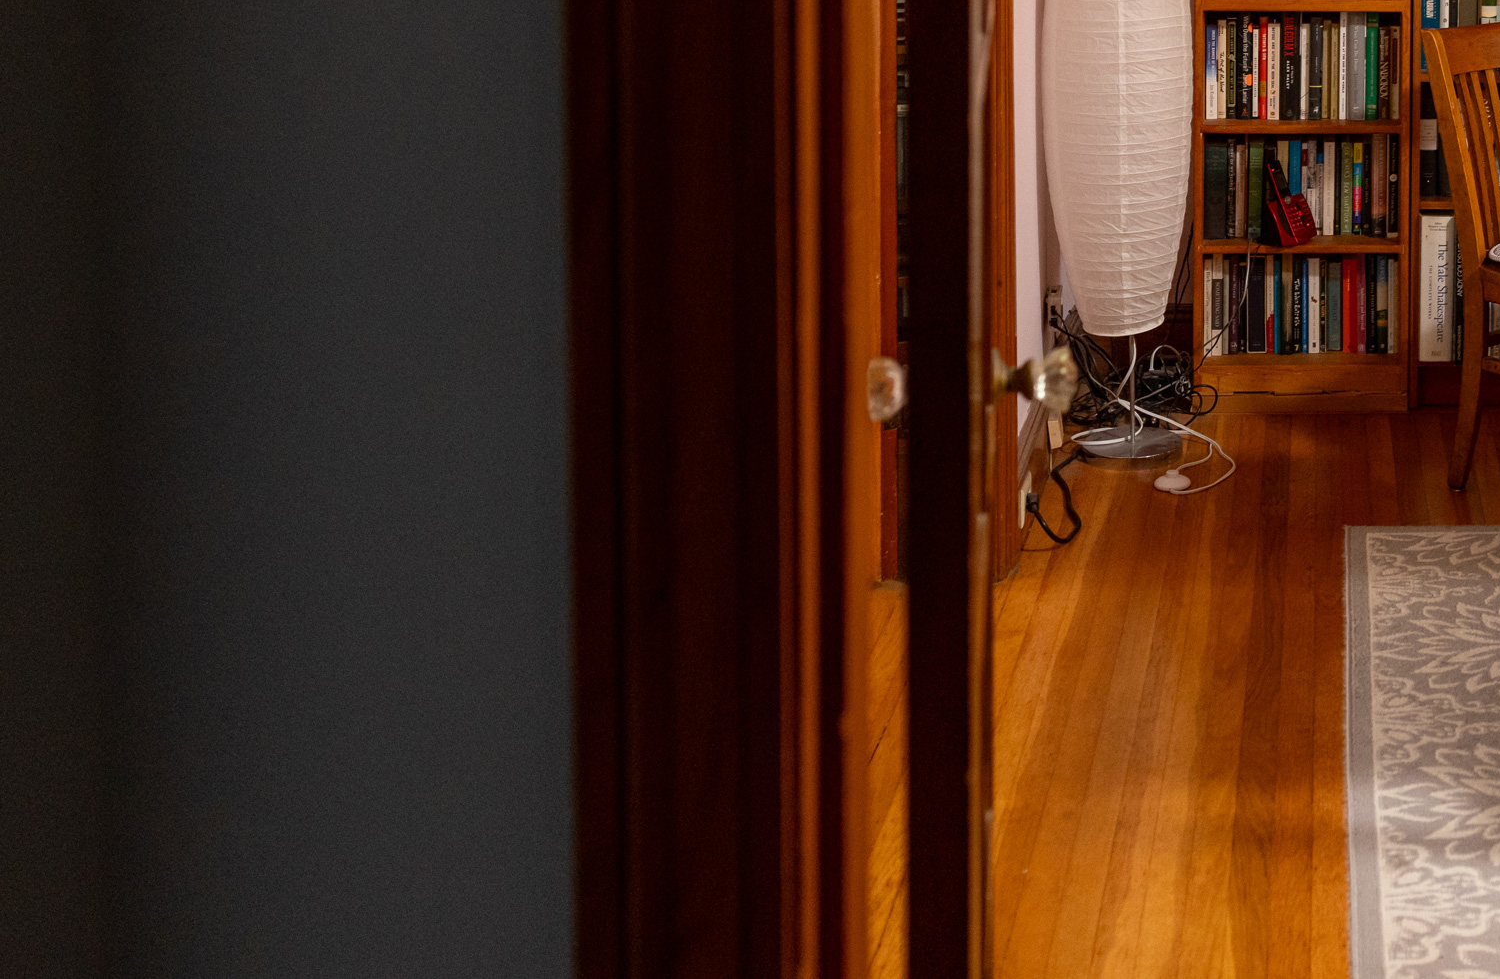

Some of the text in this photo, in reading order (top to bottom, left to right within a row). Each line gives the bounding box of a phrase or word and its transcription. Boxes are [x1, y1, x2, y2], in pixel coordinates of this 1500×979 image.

[1284, 16, 1294, 49] MALCOLM
[1354, 50, 1359, 58] Be
[1379, 61, 1389, 99] NABOKOV
[1434, 244, 1448, 343] The Yale Shakespeare
